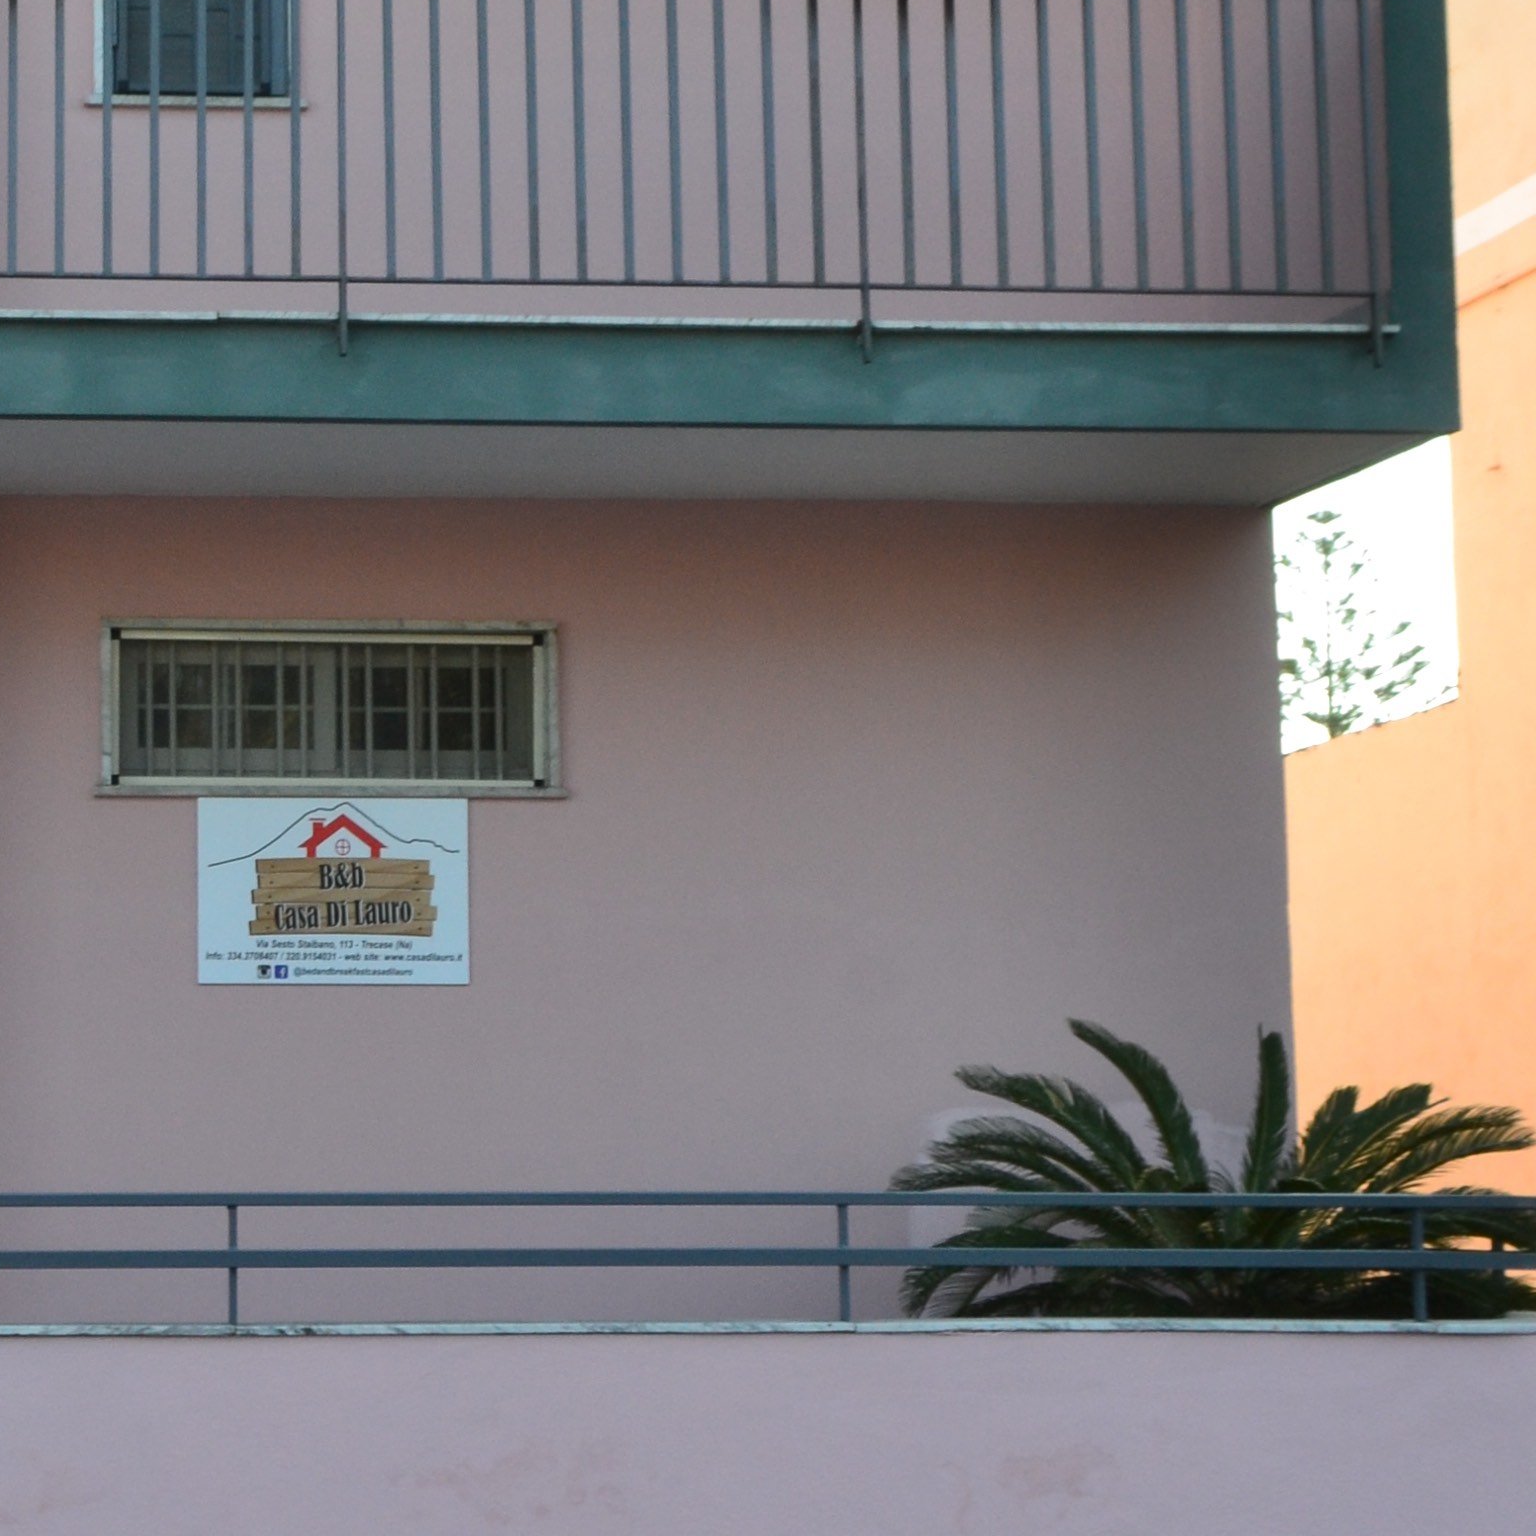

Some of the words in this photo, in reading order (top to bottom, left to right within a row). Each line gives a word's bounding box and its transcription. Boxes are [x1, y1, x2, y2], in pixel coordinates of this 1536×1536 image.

[319, 861, 364, 890] B&b
[274, 904, 319, 931] Casa
[326, 901, 348, 927] Di
[353, 899, 414, 926] Lauro
[256, 939, 269, 948] Via
[271, 939, 295, 949] Sesto
[340, 940, 354, 949] 113
[361, 940, 394, 949] Trecase
[344, 952, 361, 961] web
